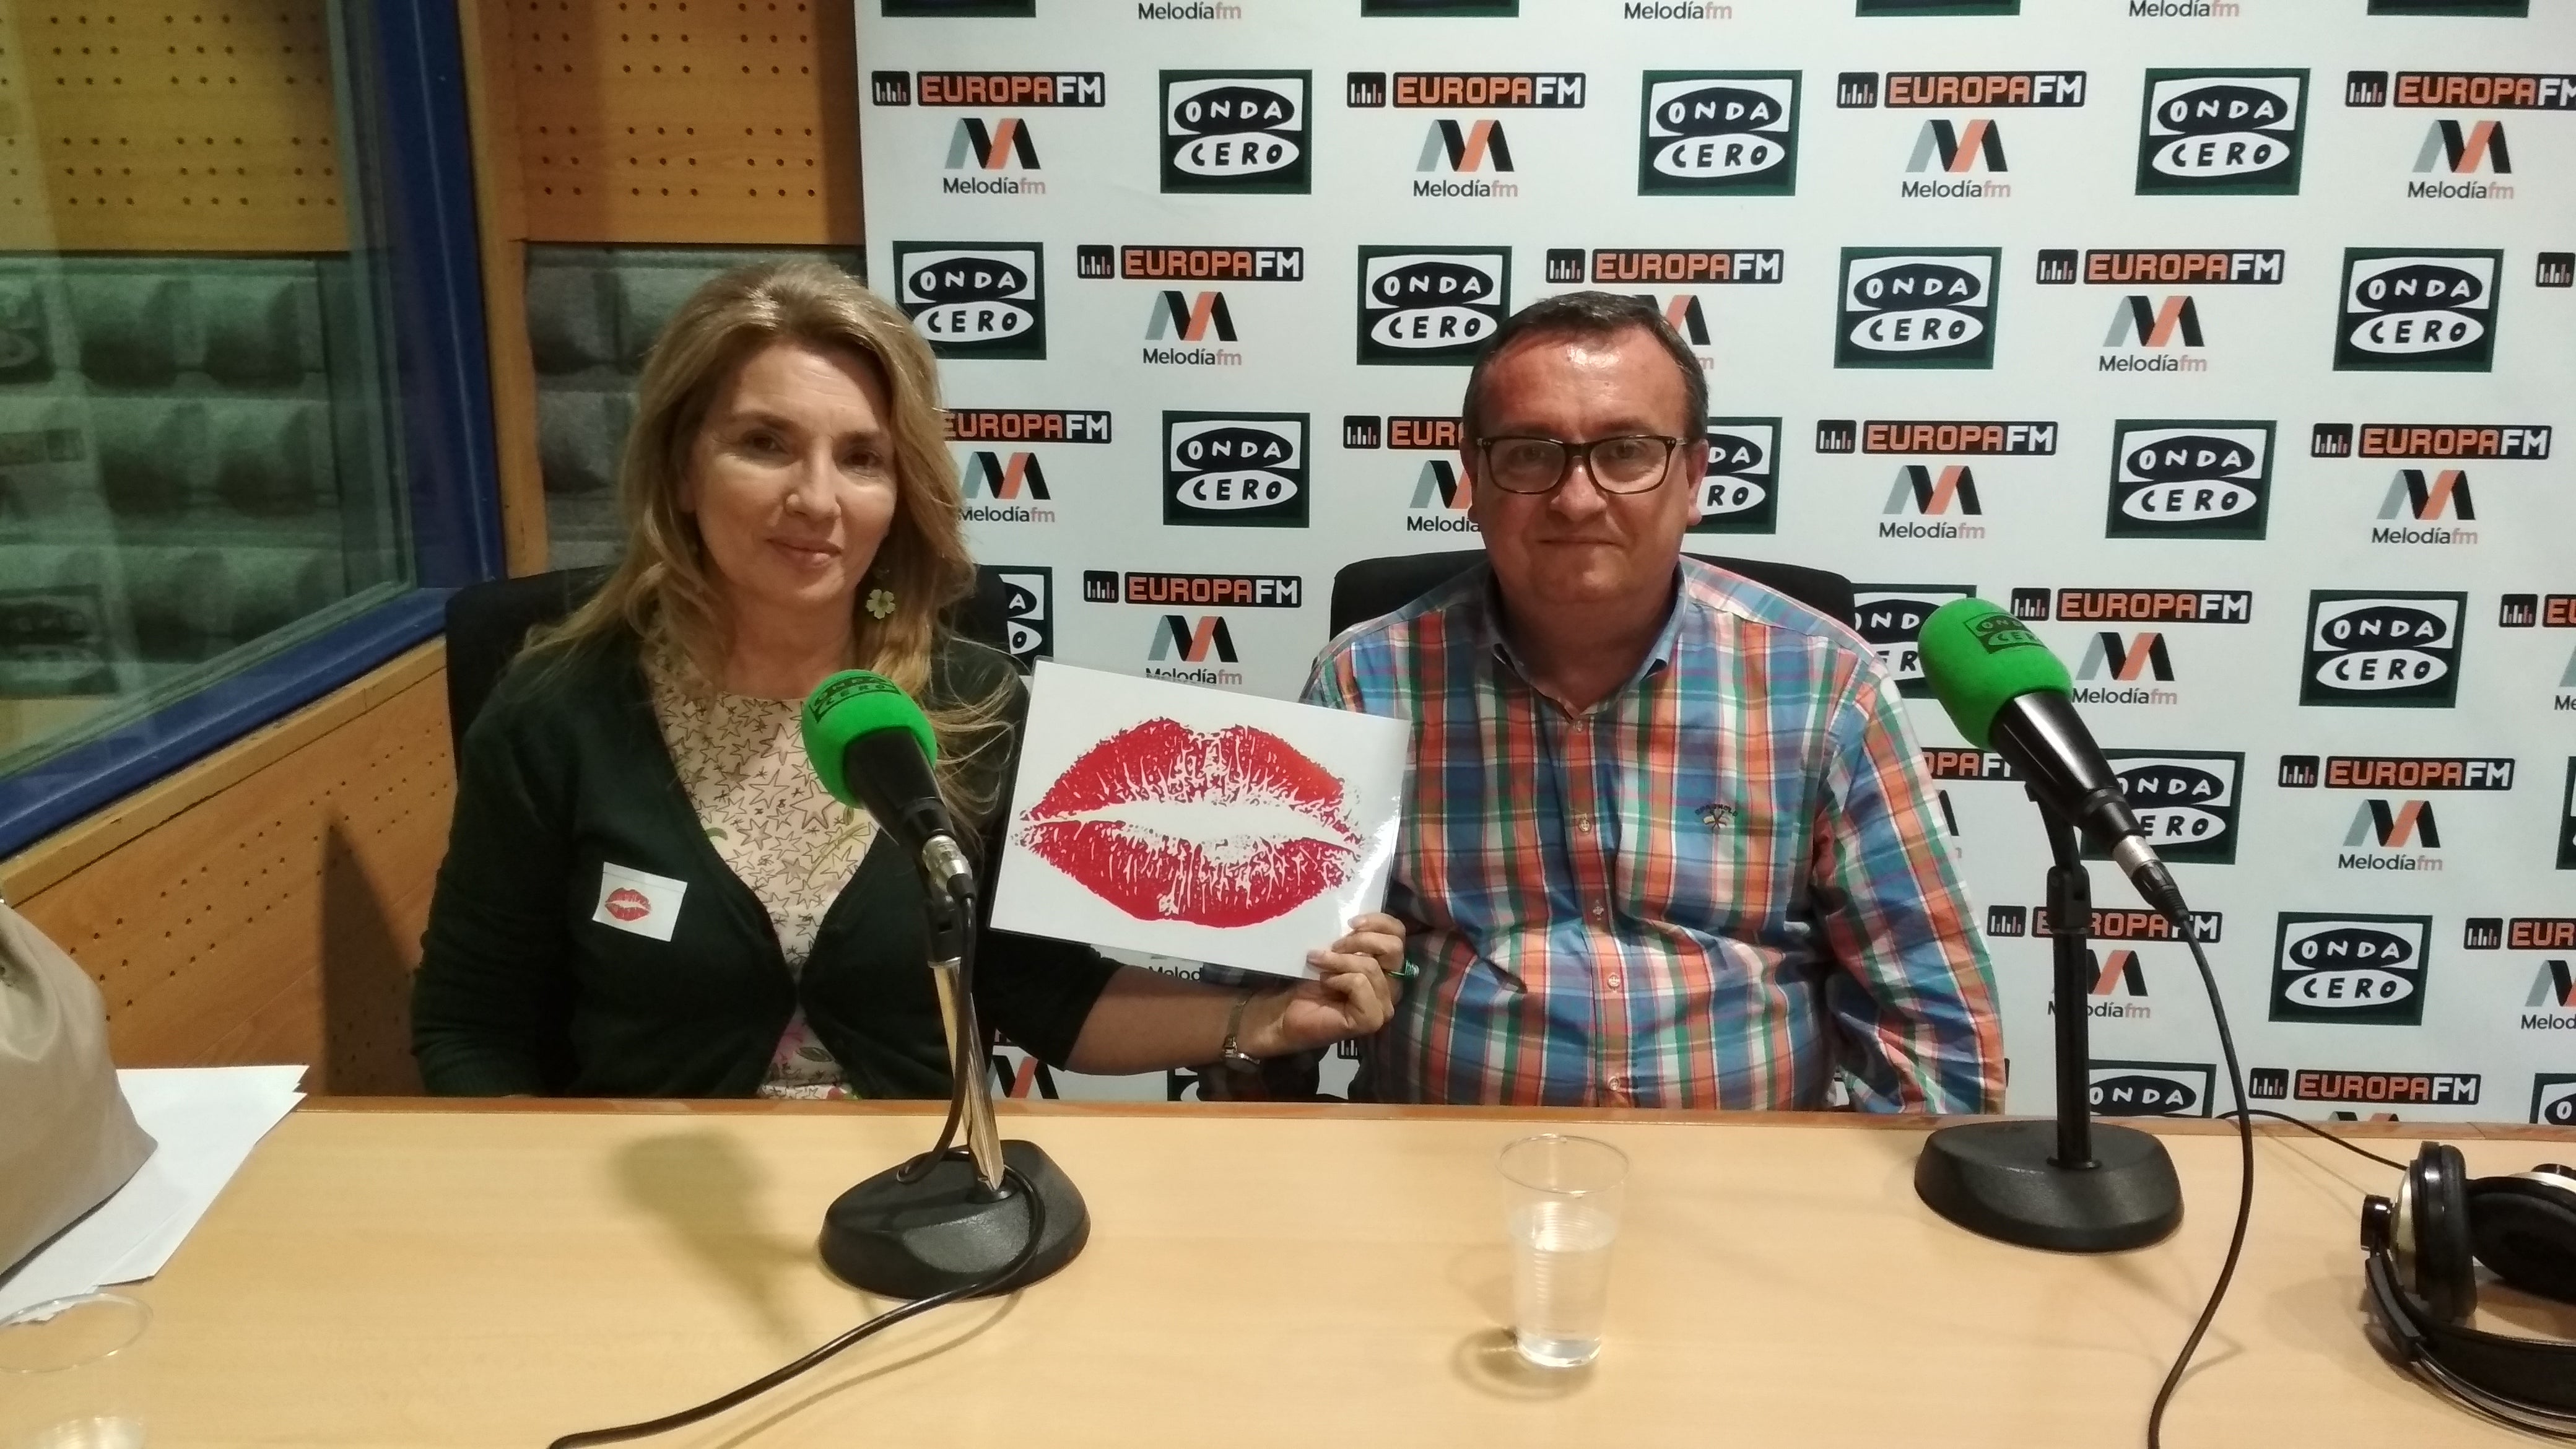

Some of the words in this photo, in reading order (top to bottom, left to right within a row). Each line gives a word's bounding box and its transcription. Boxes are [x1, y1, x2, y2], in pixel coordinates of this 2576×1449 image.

[1138, 1, 1242, 19] Melodíafm
[1624, 1, 1733, 20] Melodíafm
[922, 76, 1102, 103] EUROPAFM
[1397, 76, 1582, 105] EUROPAFM
[1889, 74, 2082, 105] EUROPAFM
[1186, 100, 1283, 123] ONDA
[1669, 99, 1770, 123] ONDA
[2170, 98, 2276, 123] ONDA
[1191, 141, 1283, 167] CERO
[1673, 143, 1769, 168] CERO
[2172, 141, 2272, 167] CERO
[943, 176, 1046, 195] Melodíafm
[1414, 179, 1518, 198] Melodíafm
[1902, 180, 2011, 199] Melodíafm
[2407, 180, 2513, 199] Melodíafm
[1125, 250, 1299, 278] EUROPAFM
[1596, 253, 1780, 280] EUROPAFM
[2089, 253, 2281, 282] EUROPAFM
[920, 271, 1016, 292] ONDA
[1384, 276, 1481, 297] ONDA
[1866, 276, 1968, 298] ONDA
[2369, 277, 2470, 298] ONDA
[928, 310, 1017, 333] CERO
[1388, 316, 1481, 339] CERO
[1869, 319, 1965, 342] CERO
[2370, 320, 2467, 344] CERO
[1143, 348, 1242, 367] Melodíafm
[2099, 354, 2207, 373] Melodíafm
[1867, 425, 2054, 452] EUROPAFM
[2362, 429, 2547, 456] EUROPAFM
[1189, 440, 1282, 461] ONDA
[2139, 449, 2242, 469] ONDA
[1193, 478, 1281, 501] CERO
[2141, 489, 2239, 513] CERO
[1879, 521, 1985, 539] Melodíafm
[2371, 528, 2478, 545] Melodíafm
[1129, 576, 1298, 605] EUROPAFM
[2061, 592, 2248, 621] EUROPAFM
[2333, 619, 2435, 640] ONDA
[2335, 658, 2431, 682] CERO
[2072, 686, 2177, 705] Melodíafm
[2330, 760, 2510, 787] EUROPAFM
[2141, 815, 2209, 837] ERO
[2338, 853, 2442, 872] Melodíafm
[2302, 939, 2399, 960] ONDA
[2304, 978, 2397, 1000] CERO
[2089, 1086, 2184, 1105] ONDA
[2299, 1073, 2476, 1102] EUROPAFM
